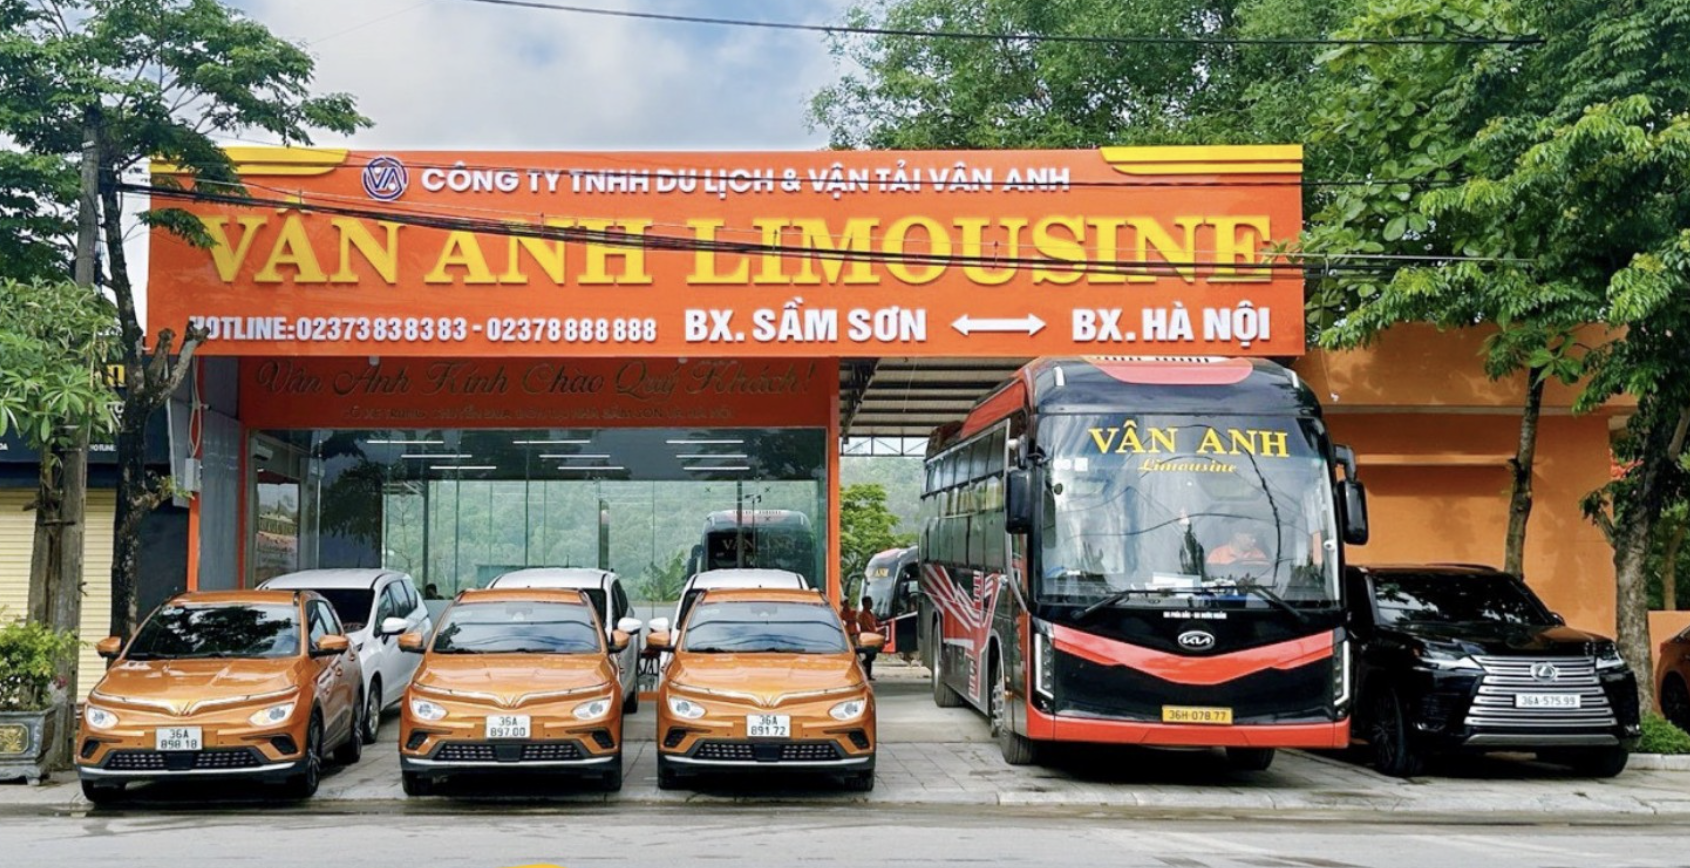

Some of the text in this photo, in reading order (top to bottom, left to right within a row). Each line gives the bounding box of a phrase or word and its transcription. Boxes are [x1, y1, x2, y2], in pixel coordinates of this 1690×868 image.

[421, 159, 1071, 199] CÔNG TY TNHH DU LỊCH & VẬN TẢI VÂN ANH
[199, 196, 1273, 285] VÂN ANH LIMOUSINE
[486, 316, 658, 342] 02378888888
[684, 297, 927, 342] BX. SẦM SƠN
[1072, 300, 1270, 348] BX. HÀ NỘI
[256, 360, 323, 396] Vân
[333, 361, 414, 397] Anh
[420, 359, 509, 396] Kính
[521, 362, 605, 397] Chào
[613, 360, 682, 401] Quý
[1087, 419, 1290, 458] VÂN ANH
[1137, 456, 1238, 474] Limousine
[169, 728, 189, 739] 36A
[759, 714, 778, 726] 36A
